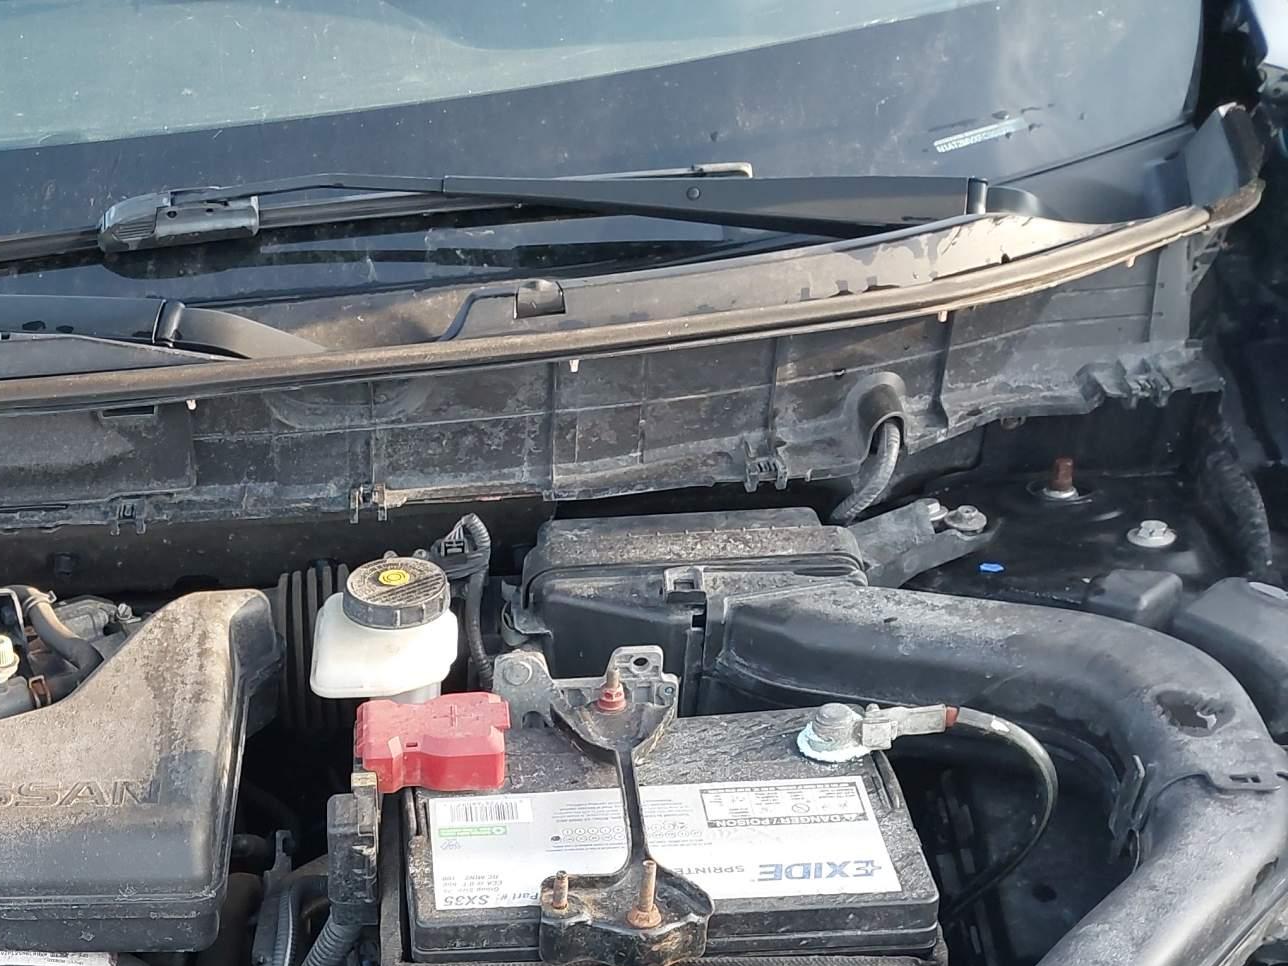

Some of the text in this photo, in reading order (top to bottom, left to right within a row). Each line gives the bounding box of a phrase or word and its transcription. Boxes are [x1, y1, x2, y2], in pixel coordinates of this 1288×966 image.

[716, 817, 771, 828] POISON
[674, 860, 882, 882] EXIDE SPRINTE
[443, 894, 490, 907] SX35
[512, 892, 539, 901] Part
